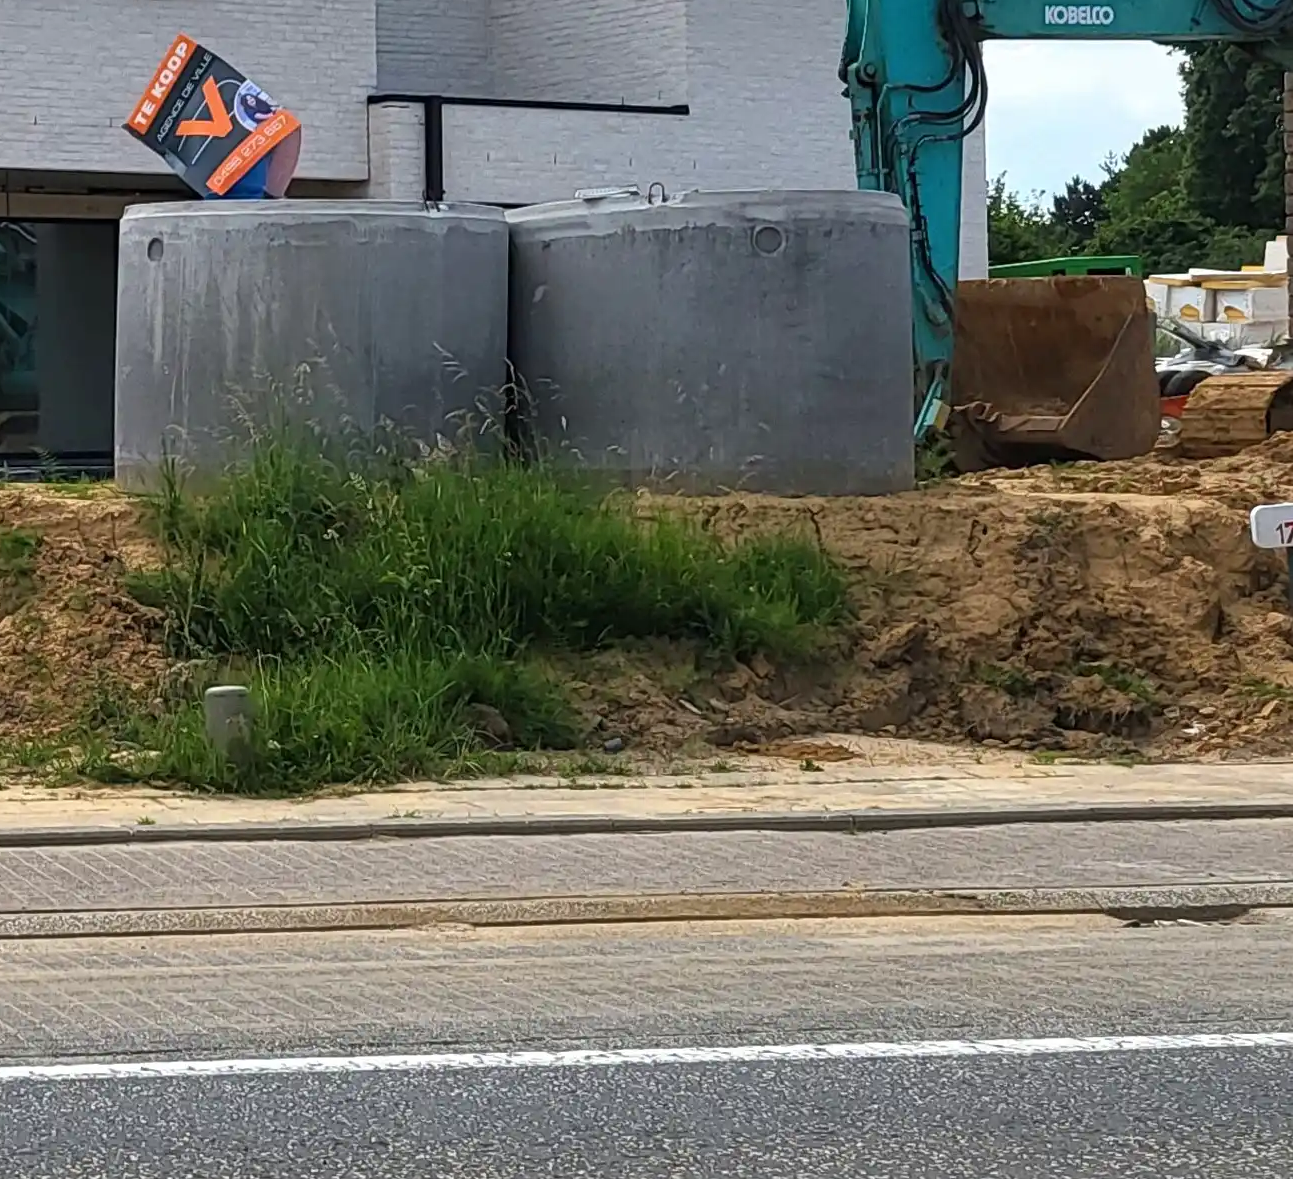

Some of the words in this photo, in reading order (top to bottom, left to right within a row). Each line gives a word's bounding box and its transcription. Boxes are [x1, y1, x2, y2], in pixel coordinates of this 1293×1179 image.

[1044, 5, 1115, 25] KOBELCO
[133, 99, 156, 125] TE
[151, 42, 188, 99] KOOP
[156, 99, 185, 142] AGENCE
[181, 81, 195, 99] DE
[192, 52, 213, 81] VILLE
[240, 134, 266, 157] 273
